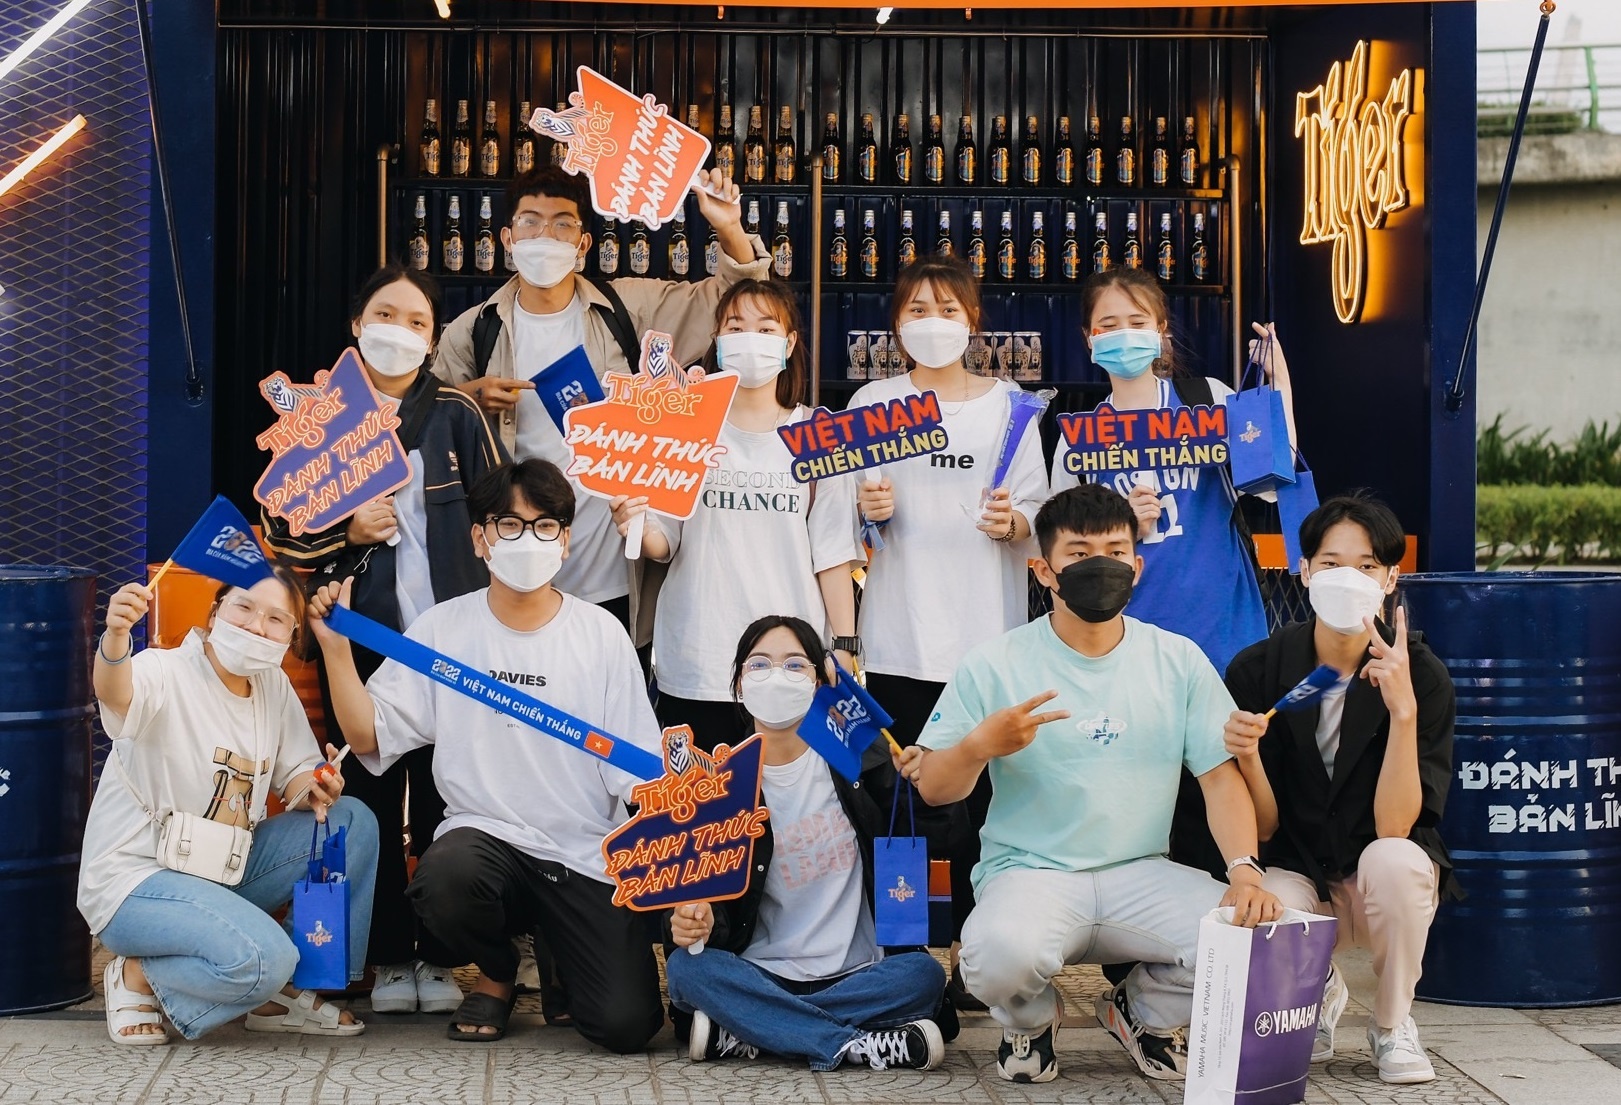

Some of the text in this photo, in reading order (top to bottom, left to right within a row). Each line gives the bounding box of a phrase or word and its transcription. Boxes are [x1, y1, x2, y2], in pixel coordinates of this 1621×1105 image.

[566, 101, 618, 173] Tiger
[610, 96, 663, 218] ĐÁNH THỨC
[639, 123, 685, 226] BẢN LĨNH
[1295, 39, 1410, 323] Tiger
[600, 251, 618, 262] Tiger
[631, 251, 649, 262] Tiger
[706, 252, 717, 263] Tig
[608, 375, 703, 424] Tiger
[259, 387, 347, 458] Tiger
[781, 394, 940, 454] VIỆT NAM
[1060, 406, 1225, 449] VIỆT NAM
[267, 403, 397, 514] ĐÁNH THỨC
[567, 422, 728, 468] ĐÁNH THỨC
[795, 425, 946, 482] CHIẾN THẮNG
[930, 452, 974, 470] me
[1066, 435, 1227, 472] CHIẾN THẮNG
[289, 440, 393, 533] BẢN LĨNH
[568, 451, 699, 493] BẢN LĨNH
[702, 489, 800, 514] CHANCE
[462, 676, 484, 694] VIỆT
[486, 688, 512, 708] NAM
[512, 701, 545, 724] CHIẾN
[546, 719, 582, 741] THẮNG
[1458, 748, 1578, 790] ĐÁNH
[635, 769, 733, 823] Tiger
[1488, 793, 1576, 833] BẢN
[609, 808, 767, 875] ĐÁNH THỨC
[618, 846, 746, 904] BẢN LĨNH
[888, 888, 915, 902] Tiger
[306, 932, 332, 947] Tiger
[1203, 981, 1213, 1020] VIETNAM
[1273, 1003, 1317, 1035] YAMAHA
[1200, 1019, 1209, 1046] MUSIC
[1198, 1047, 1206, 1079] YAMAHA
